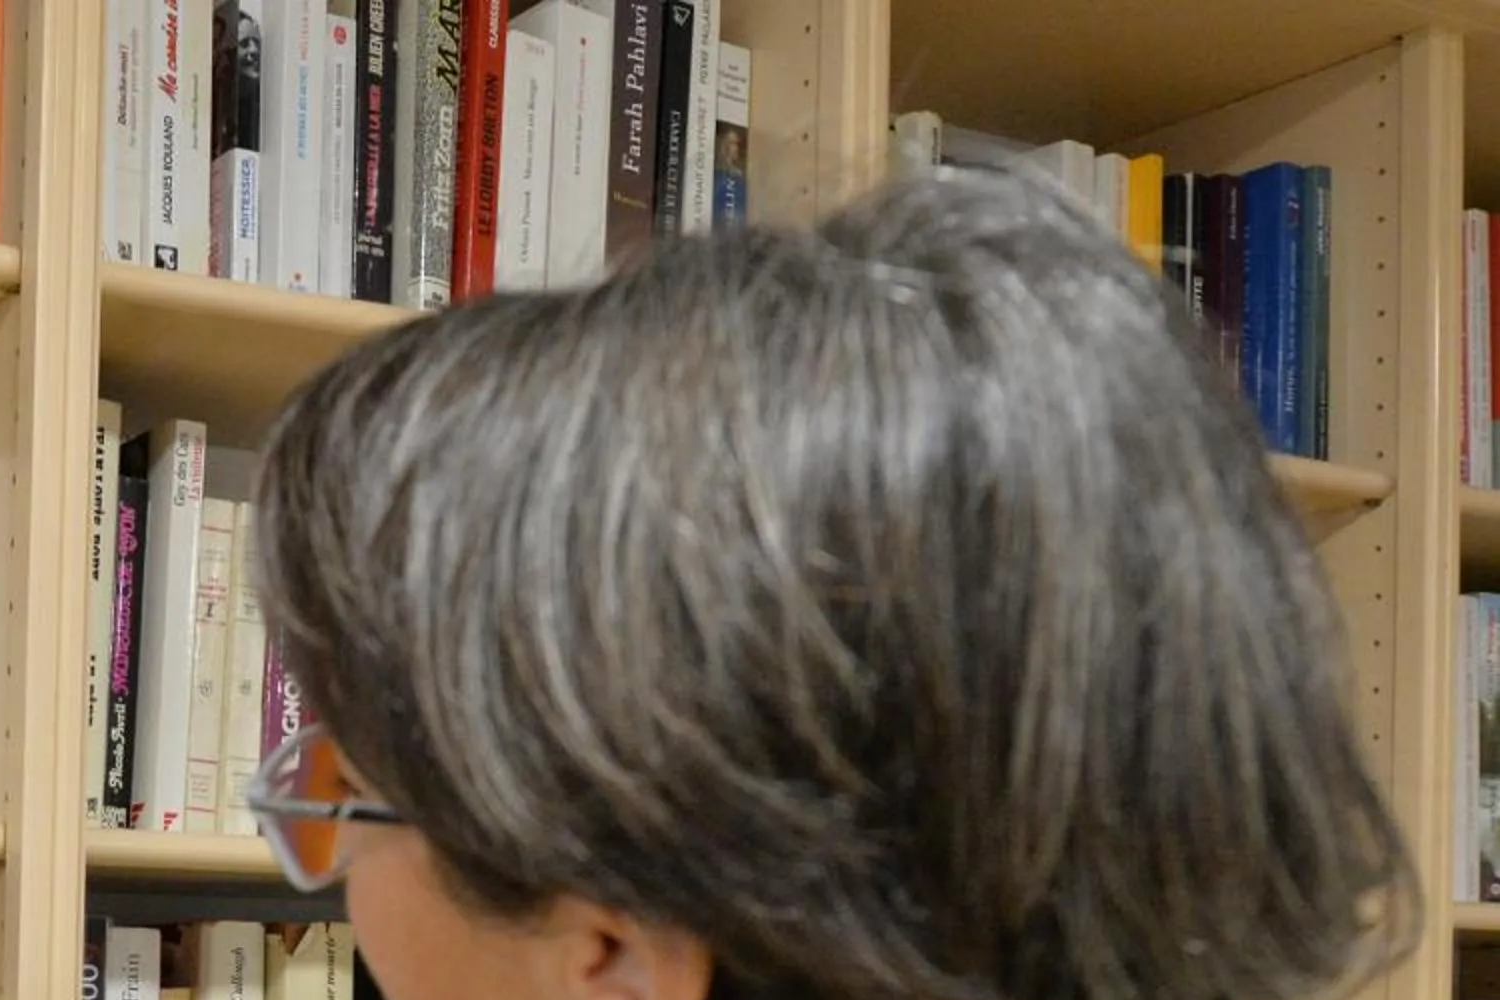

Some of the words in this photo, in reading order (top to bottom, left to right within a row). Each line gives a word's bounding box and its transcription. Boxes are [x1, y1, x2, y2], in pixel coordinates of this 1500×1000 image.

[626, 4, 647, 92] Pahlavi
[163, 114, 178, 165] ROULAND
[436, 105, 456, 168] Zorn
[481, 72, 499, 149] BRETON
[622, 103, 643, 173] Farah
[163, 168, 177, 226] JACQUES
[432, 171, 451, 232] Fritz
[478, 153, 496, 212] LOBBY
[478, 213, 491, 236] LE
